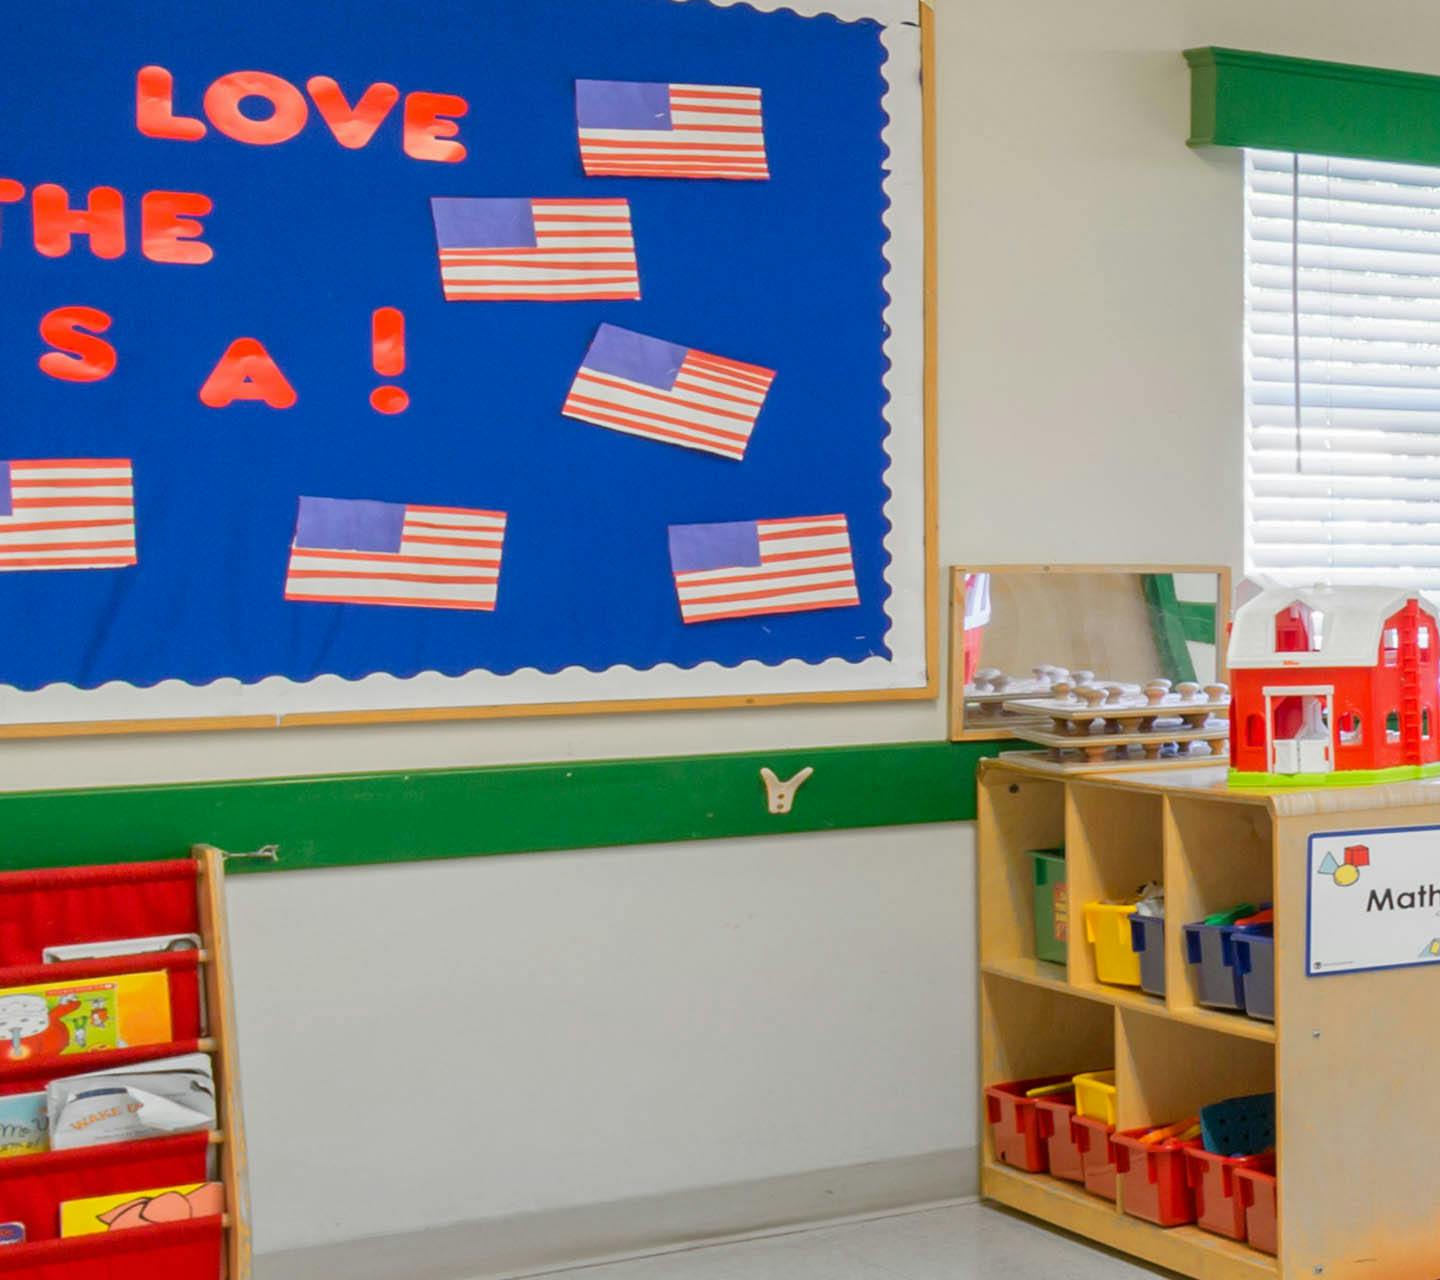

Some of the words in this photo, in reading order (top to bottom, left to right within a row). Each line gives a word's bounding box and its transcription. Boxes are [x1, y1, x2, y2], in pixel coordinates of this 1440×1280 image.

[136, 64, 470, 164] LOVE
[38, 305, 118, 384] S
[199, 337, 298, 409] A
